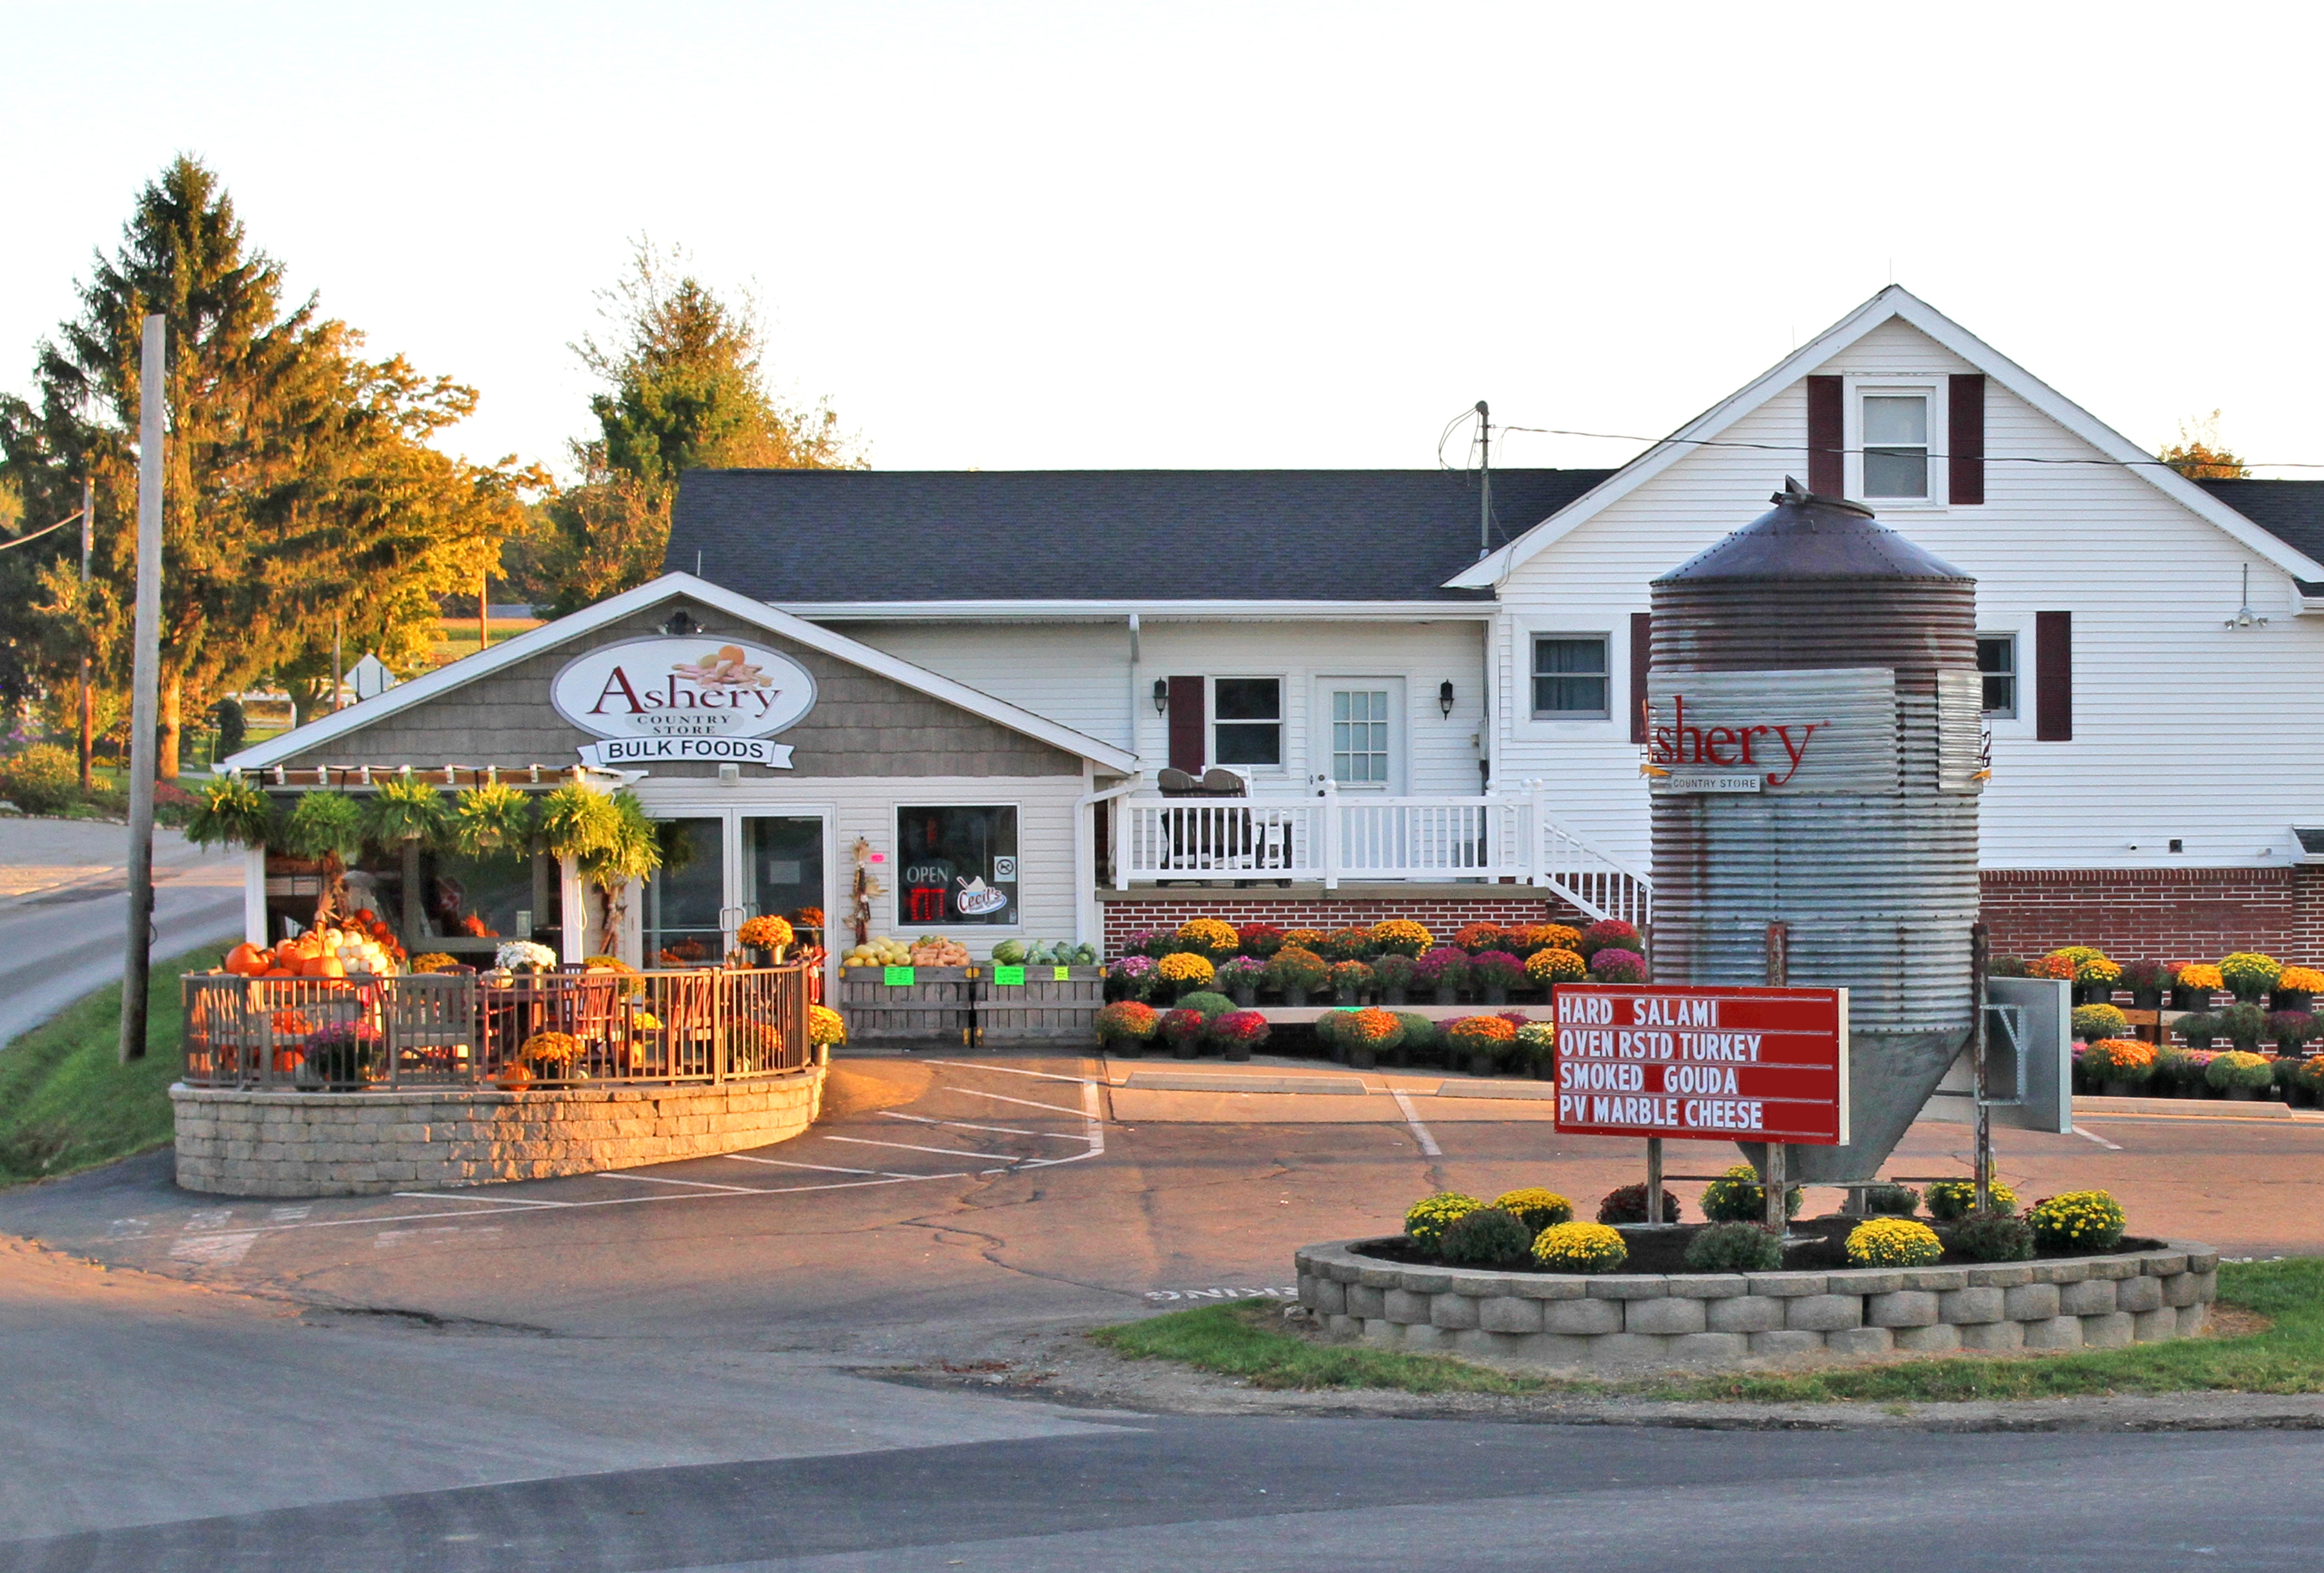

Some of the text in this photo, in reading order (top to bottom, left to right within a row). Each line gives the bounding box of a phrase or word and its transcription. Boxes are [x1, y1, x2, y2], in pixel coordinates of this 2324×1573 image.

[586, 665, 782, 718] Ashery
[637, 715, 731, 725] COUNTRY
[653, 726, 716, 734] STORE
[609, 739, 764, 759] BULK FOODS
[1673, 779, 1756, 788] COUNTRY STORE
[906, 866, 948, 883] OPEN
[959, 887, 1000, 912] Cecil's
[1558, 997, 1718, 1027] HARD SALAMI
[1559, 1030, 1762, 1062] OVEN RSTD TURKEY
[1560, 1063, 1738, 1094] SMOKED GOUDA
[1560, 1095, 1763, 1129] PV MARBLE CHEESE
